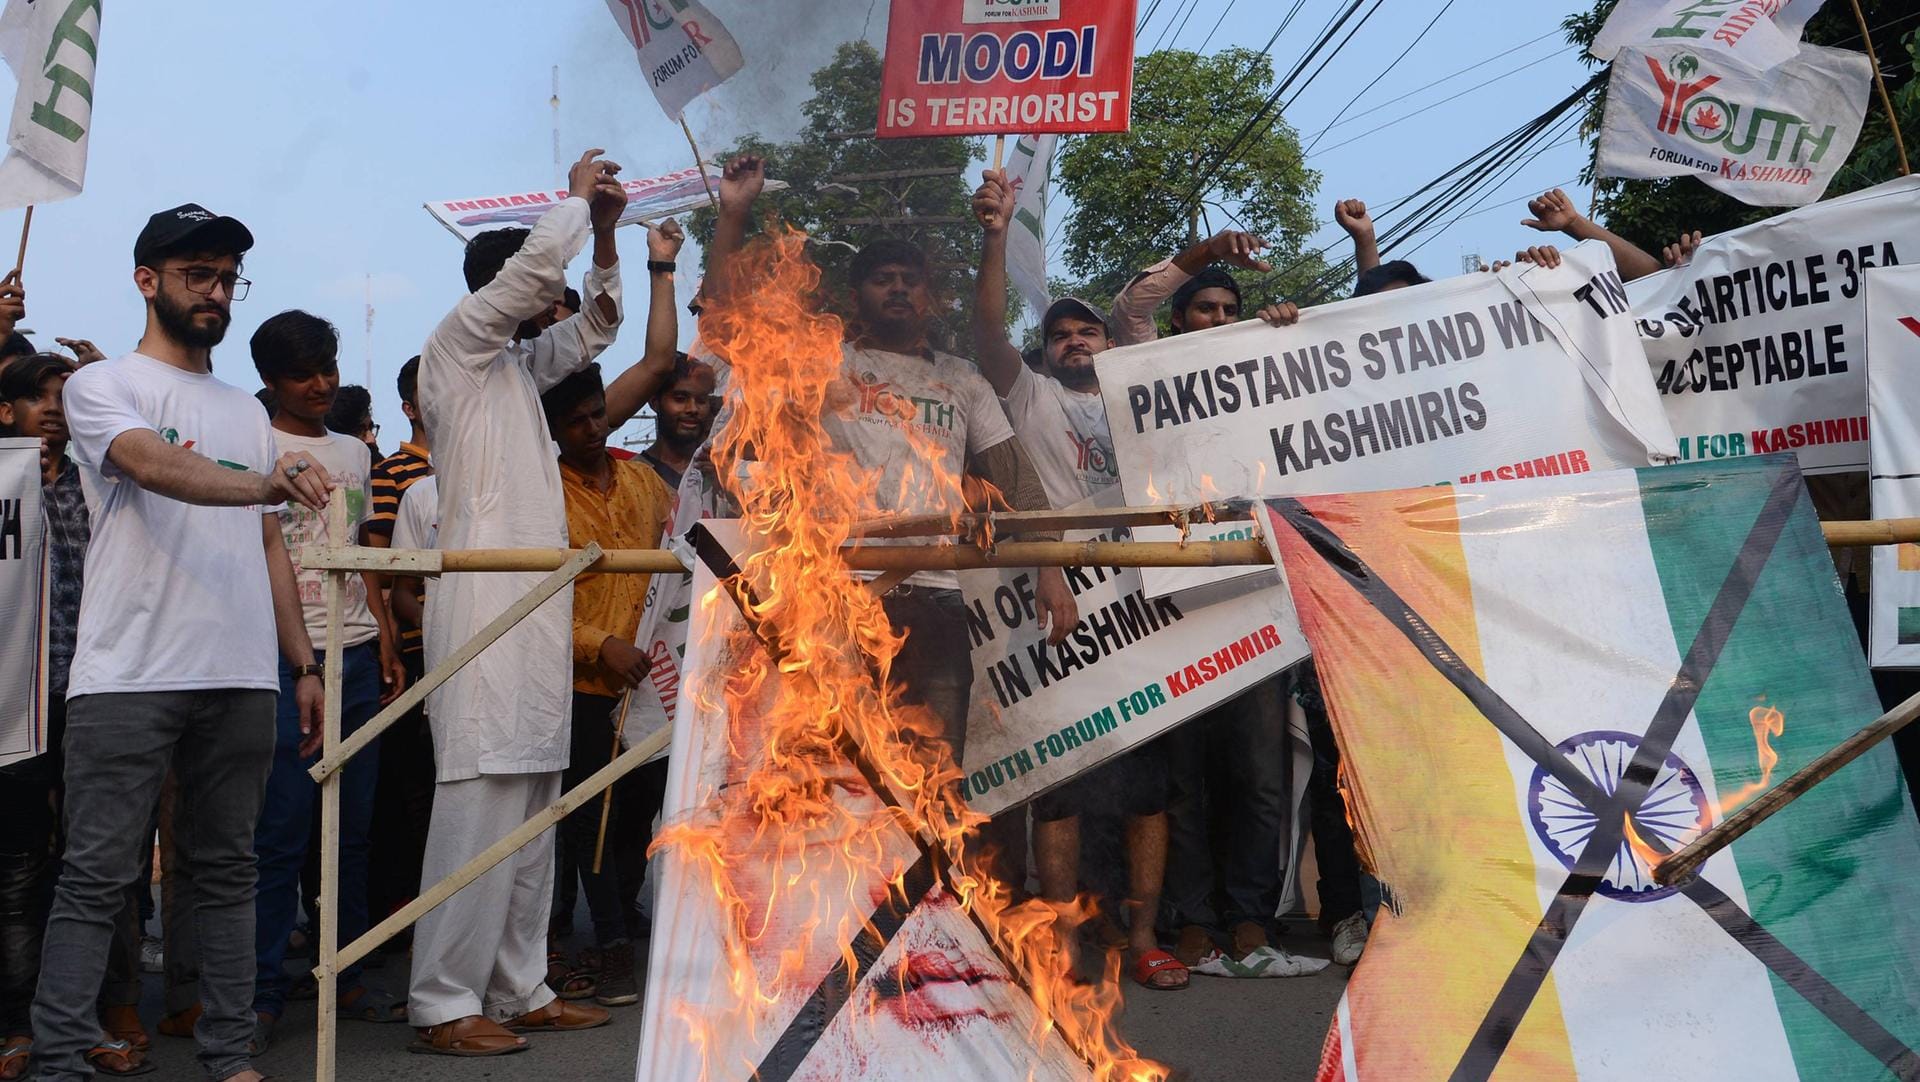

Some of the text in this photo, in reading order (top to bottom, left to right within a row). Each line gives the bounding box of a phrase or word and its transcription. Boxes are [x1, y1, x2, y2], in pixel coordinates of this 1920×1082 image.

[1012, 6, 1048, 17] KASHMIR
[652, 55, 686, 87] FORUM
[917, 25, 1097, 85] MOODI
[886, 91, 1119, 128] IS TERRIORIST
[1644, 55, 1837, 164] YOUTH
[1649, 147, 1693, 167] FORUM
[1719, 157, 1813, 185] KASHMIR
[443, 191, 553, 213] INDIAN
[1694, 254, 1830, 325] ARTICLE
[1127, 340, 1352, 434] PAKISTANIS
[1358, 311, 1486, 381] STAND
[1656, 324, 1848, 396] ACCEPTABLE
[1269, 381, 1487, 476] KASHMIRIS
[1697, 432, 1746, 459] FOR
[994, 572, 1036, 629] OF
[987, 654, 1032, 709] IN
[1027, 590, 1184, 689] KASHMIR
[960, 624, 1282, 802] YOUTH FORUM FOR KASHMIR
